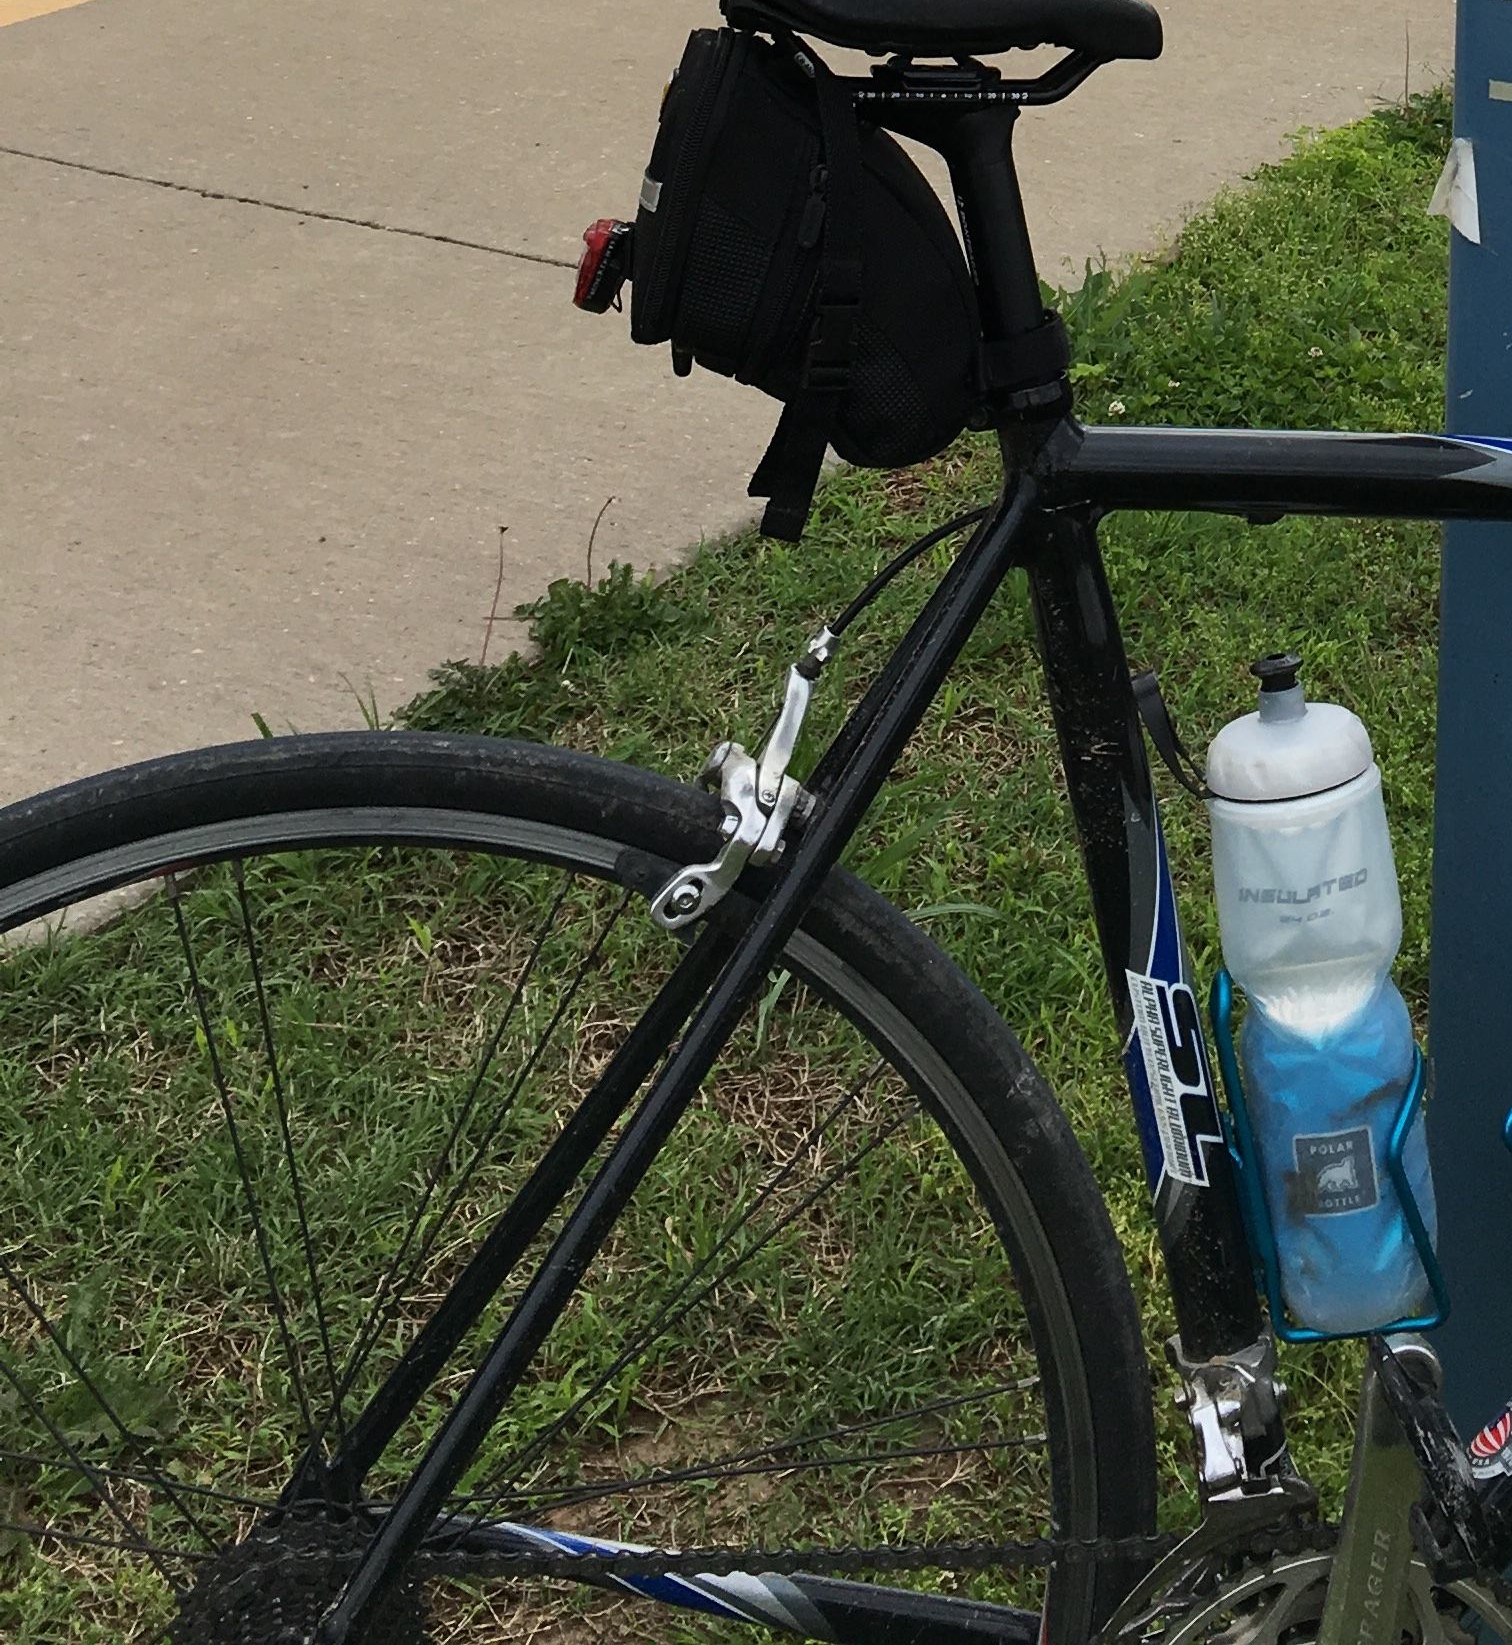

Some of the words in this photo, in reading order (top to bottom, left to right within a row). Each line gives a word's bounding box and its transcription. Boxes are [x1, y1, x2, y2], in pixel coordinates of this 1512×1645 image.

[1238, 868, 1368, 904] INSULATED
[1139, 980, 1161, 1026] ALPHA
[1150, 1026, 1177, 1105] SUPERLIGHT
[1157, 984, 1224, 1186] SL
[1309, 1140, 1353, 1155] POLAR
[1318, 1194, 1360, 1209] OTTLE
[1356, 1527, 1391, 1645] RAGER
